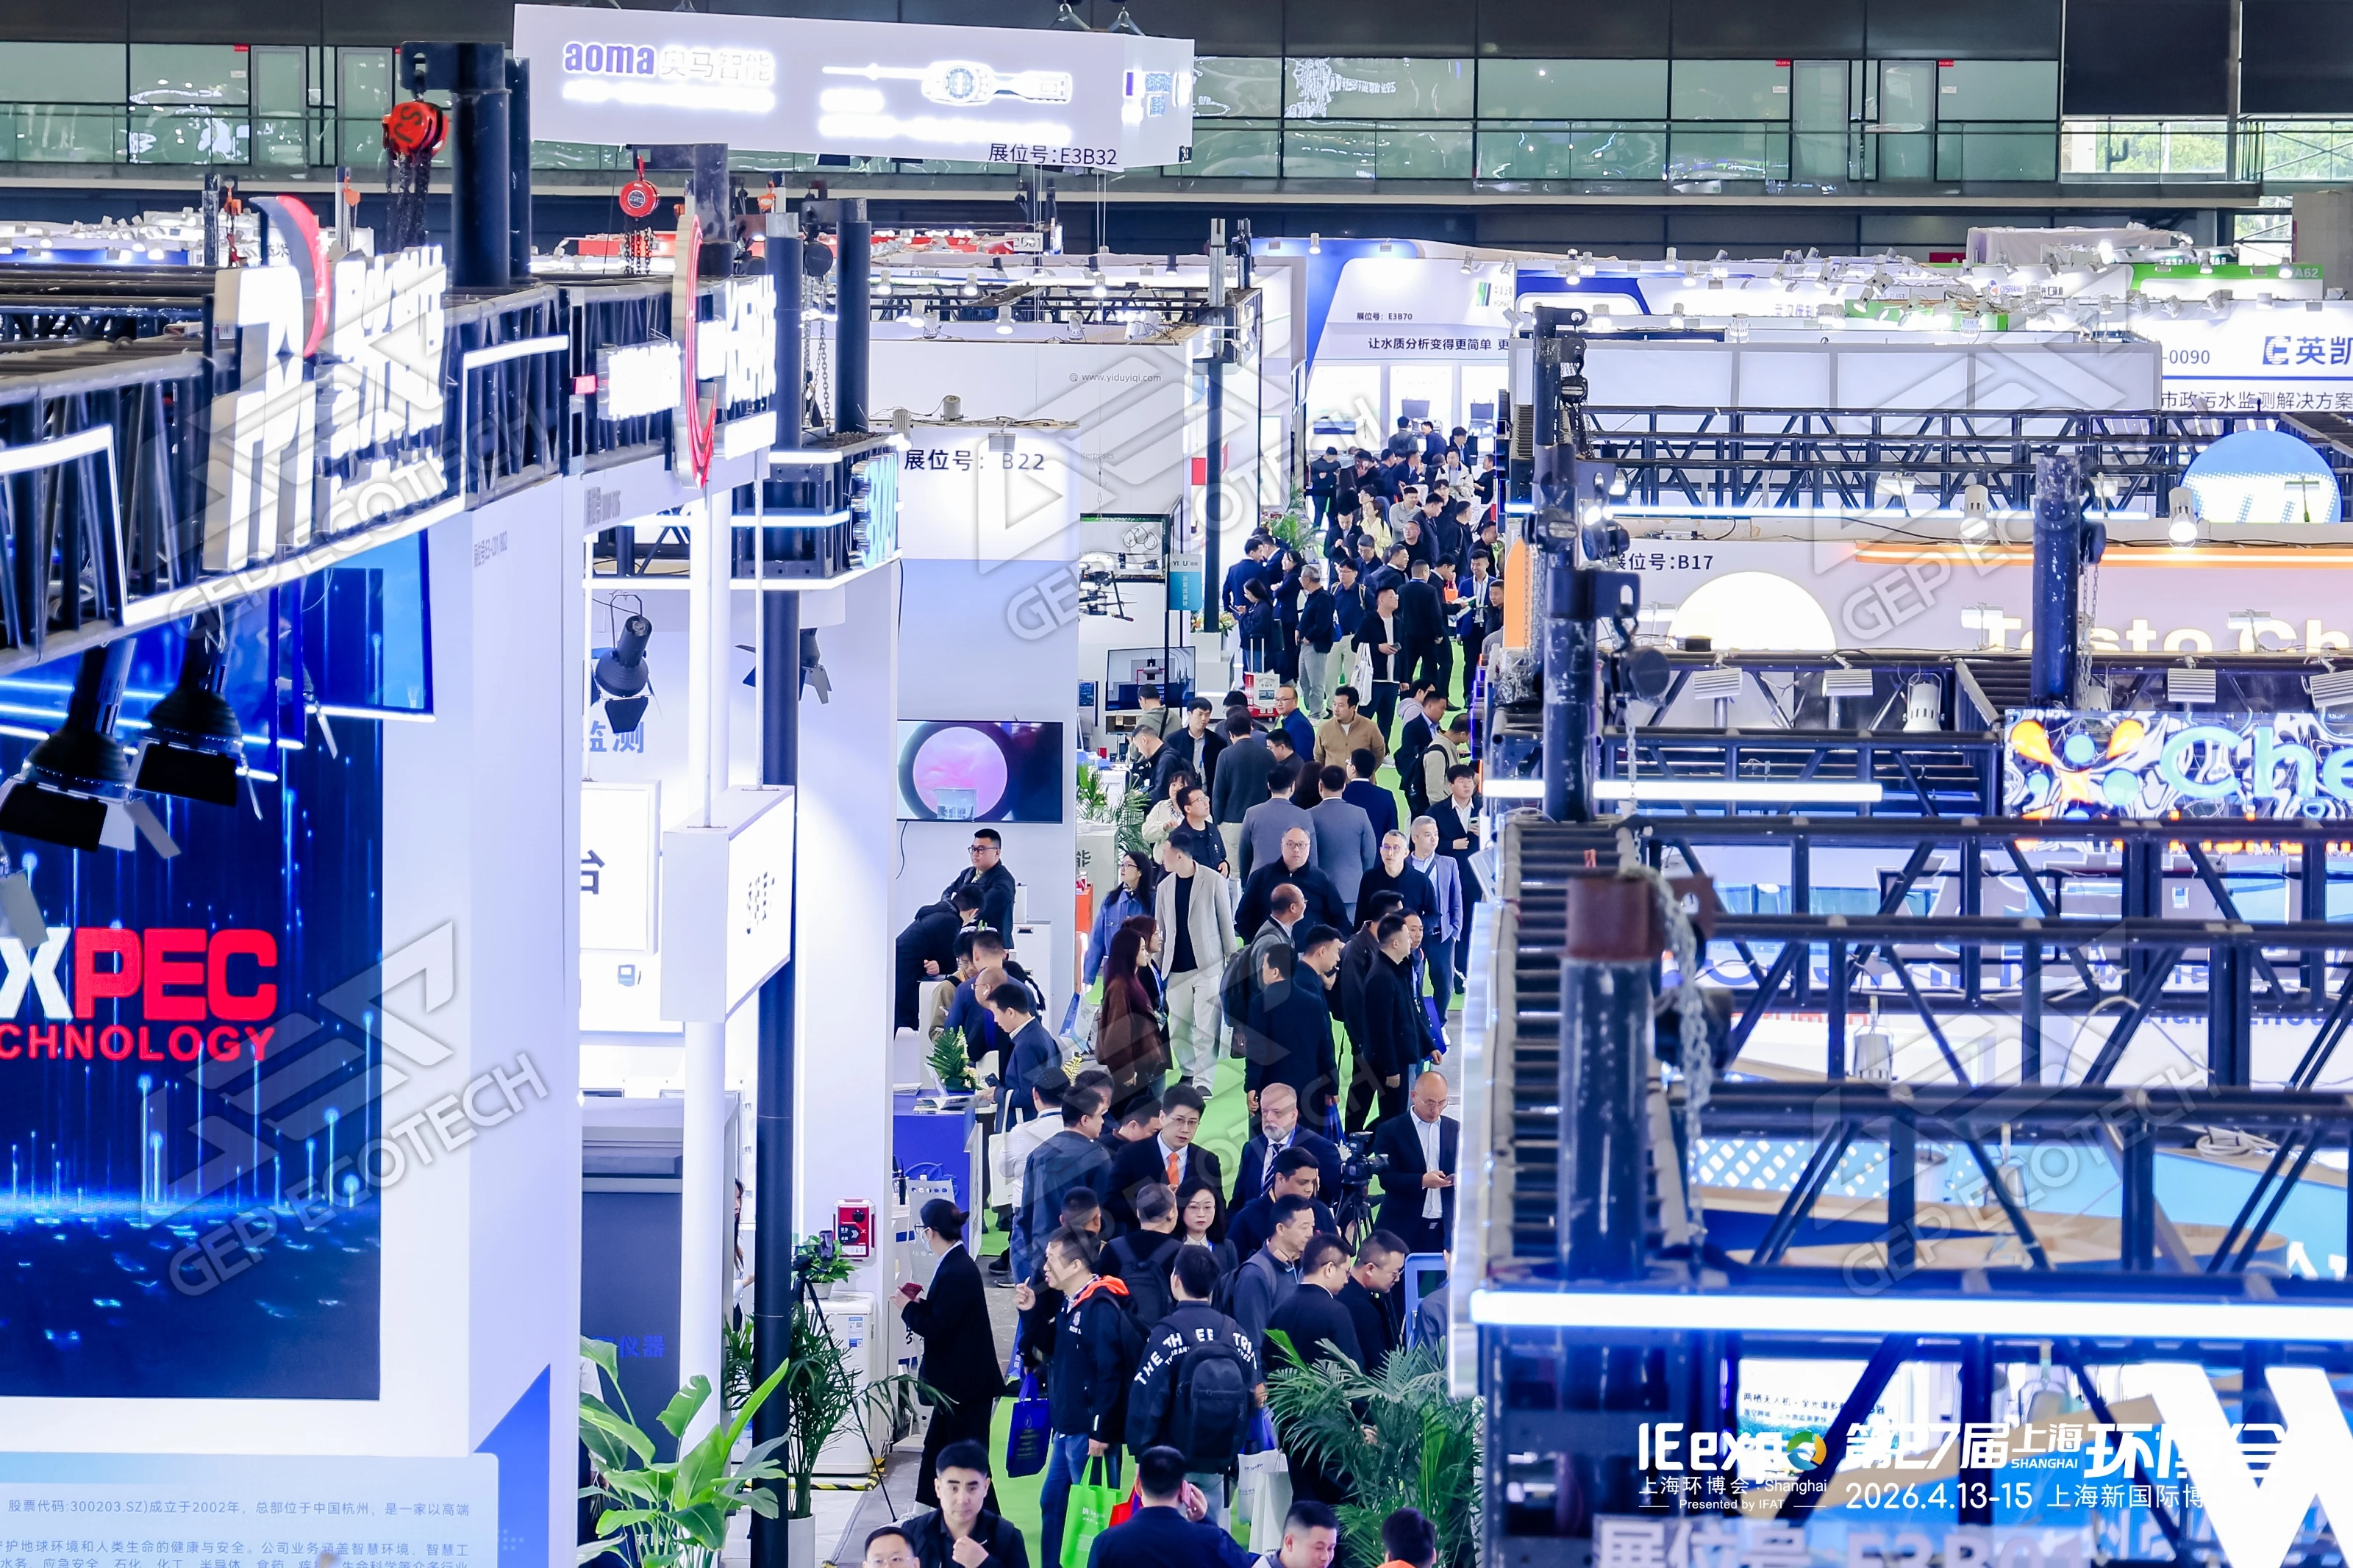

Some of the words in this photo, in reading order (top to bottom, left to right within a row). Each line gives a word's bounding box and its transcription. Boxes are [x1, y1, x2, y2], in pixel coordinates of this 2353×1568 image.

[565, 43, 654, 75] aoma
[661, 50, 771, 82] 奥马智能
[988, 143, 1118, 165] 展位号:E3B32
[1368, 337, 1492, 351] 让水质分析变得更简单
[1082, 373, 1162, 383] www.yiduyiqi.com
[2162, 390, 2353, 410] 市政污水监测解决方案
[1971, 618, 2214, 652] Tsto
[591, 1335, 665, 1358] 仪器
[1134, 1351, 1163, 1385] THE
